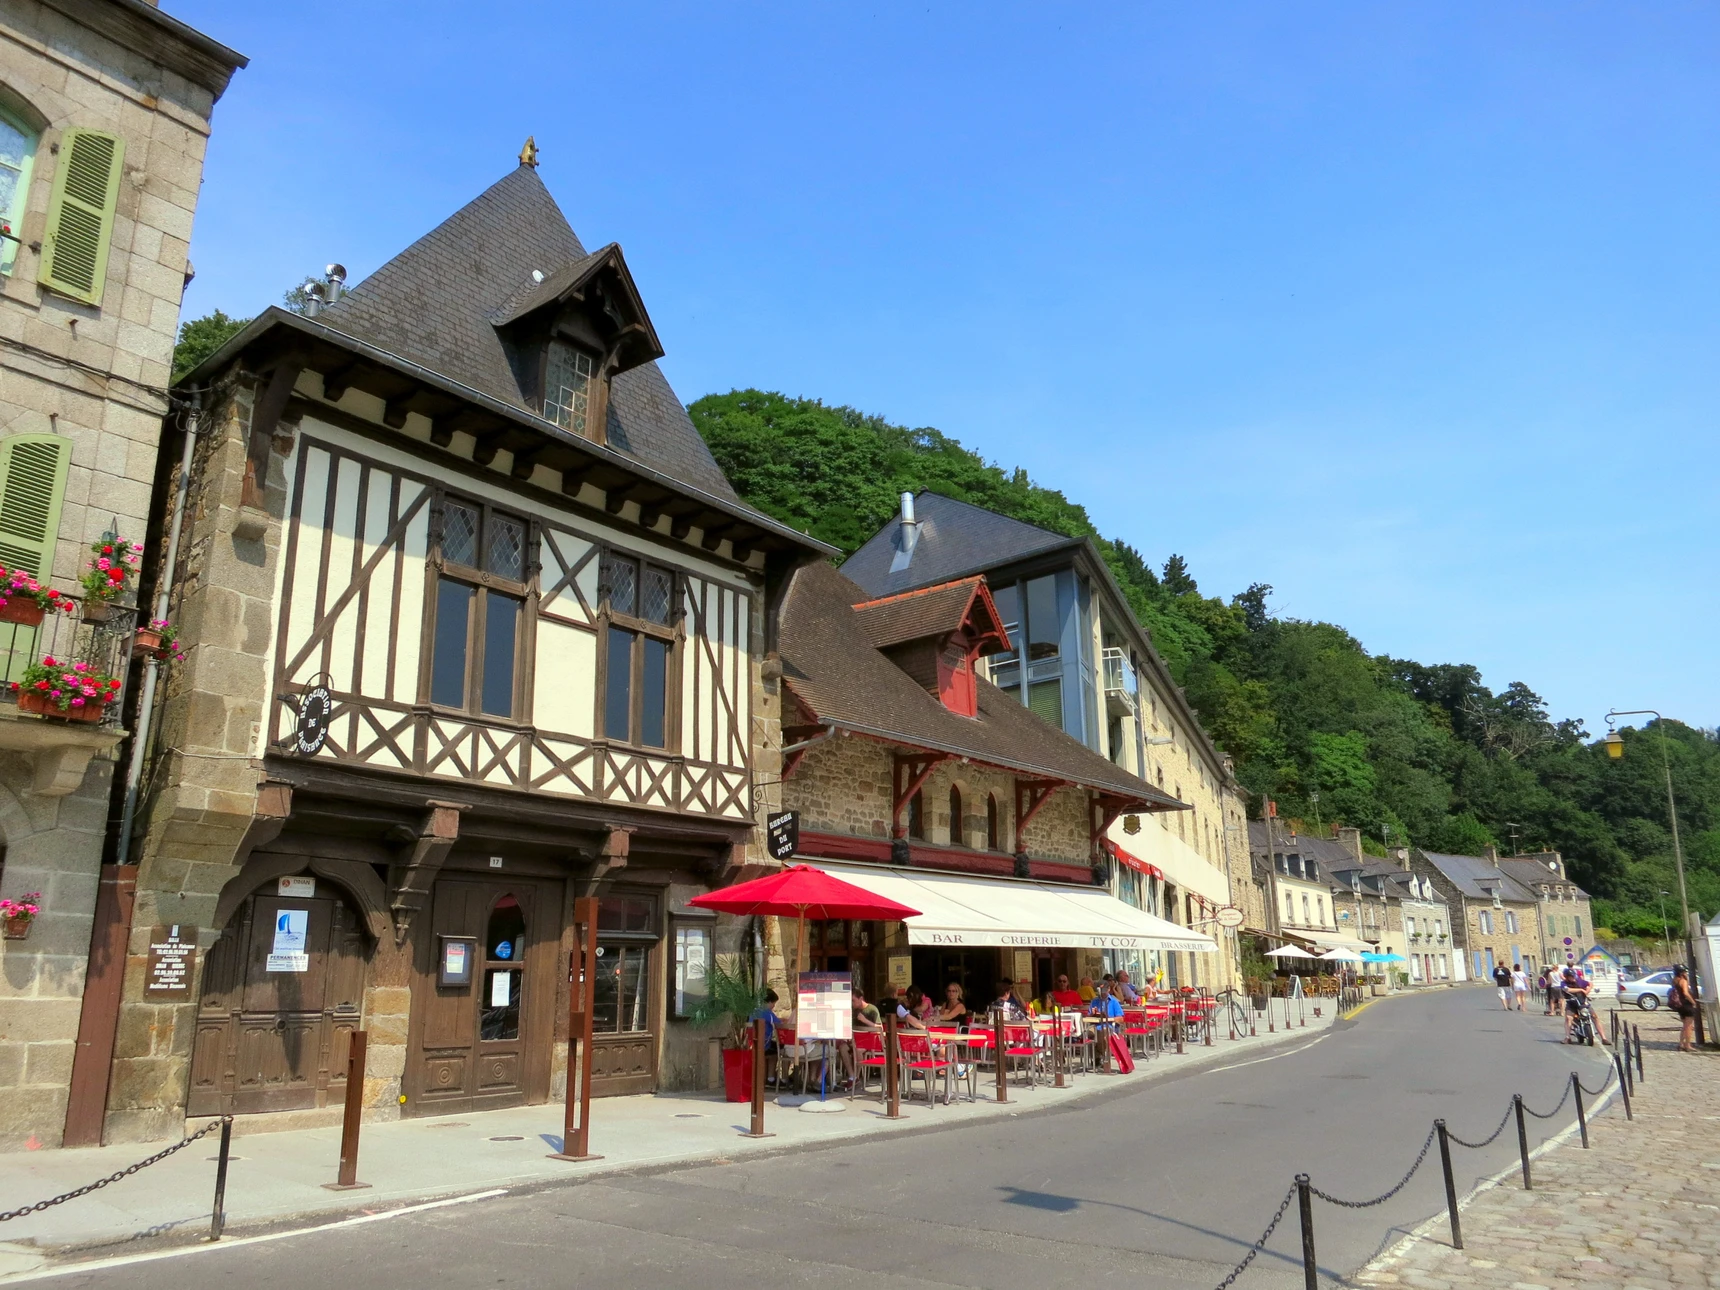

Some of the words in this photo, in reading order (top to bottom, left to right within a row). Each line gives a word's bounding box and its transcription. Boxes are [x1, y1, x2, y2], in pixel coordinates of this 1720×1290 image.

[308, 718, 317, 728] DE
[769, 812, 793, 830] BUREAU
[779, 833, 788, 844] DU
[777, 842, 793, 856] PORT
[932, 933, 964, 944] BAR
[1001, 935, 1062, 945] CREPERIE
[1089, 936, 1109, 947] TY
[1111, 937, 1139, 948] COZ
[1160, 941, 1206, 951] BRASSERIE
